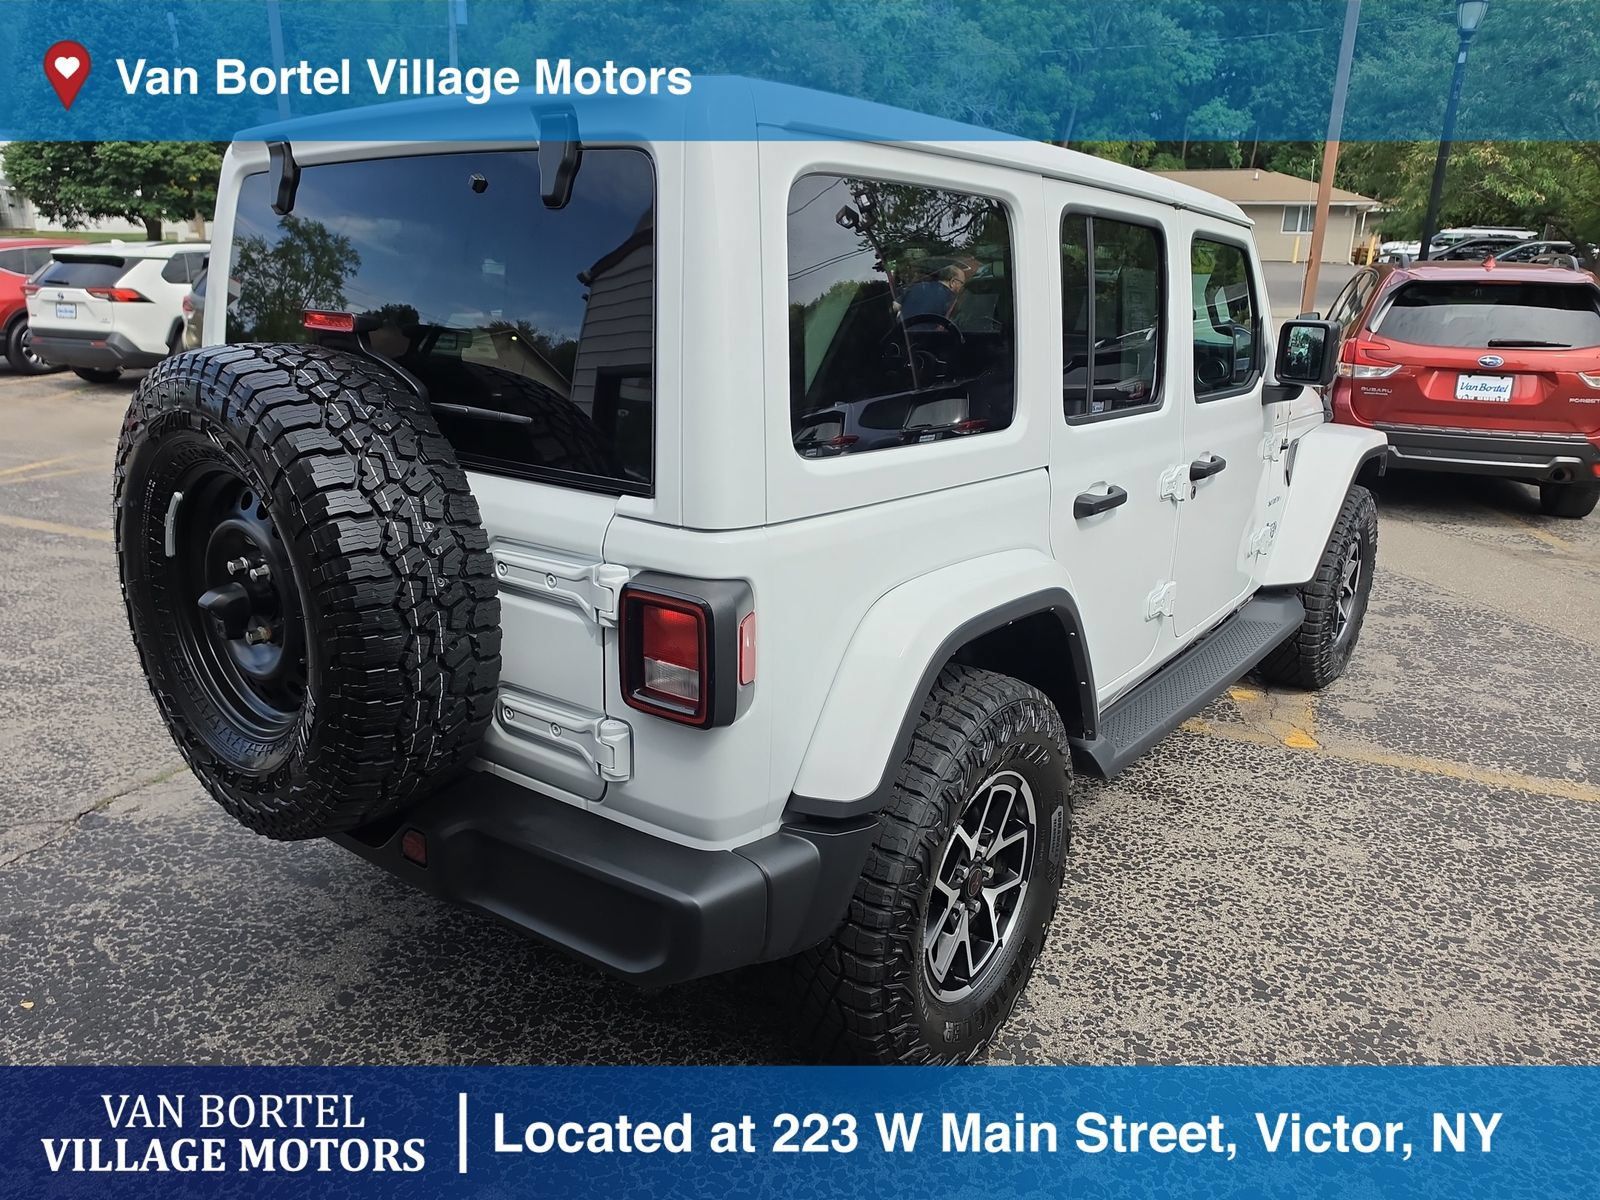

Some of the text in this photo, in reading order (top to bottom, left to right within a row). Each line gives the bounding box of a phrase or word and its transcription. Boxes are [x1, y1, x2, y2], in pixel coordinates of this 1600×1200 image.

[1360, 386, 1393, 394] SUBARU
[1460, 381, 1509, 393] Van Bortel
